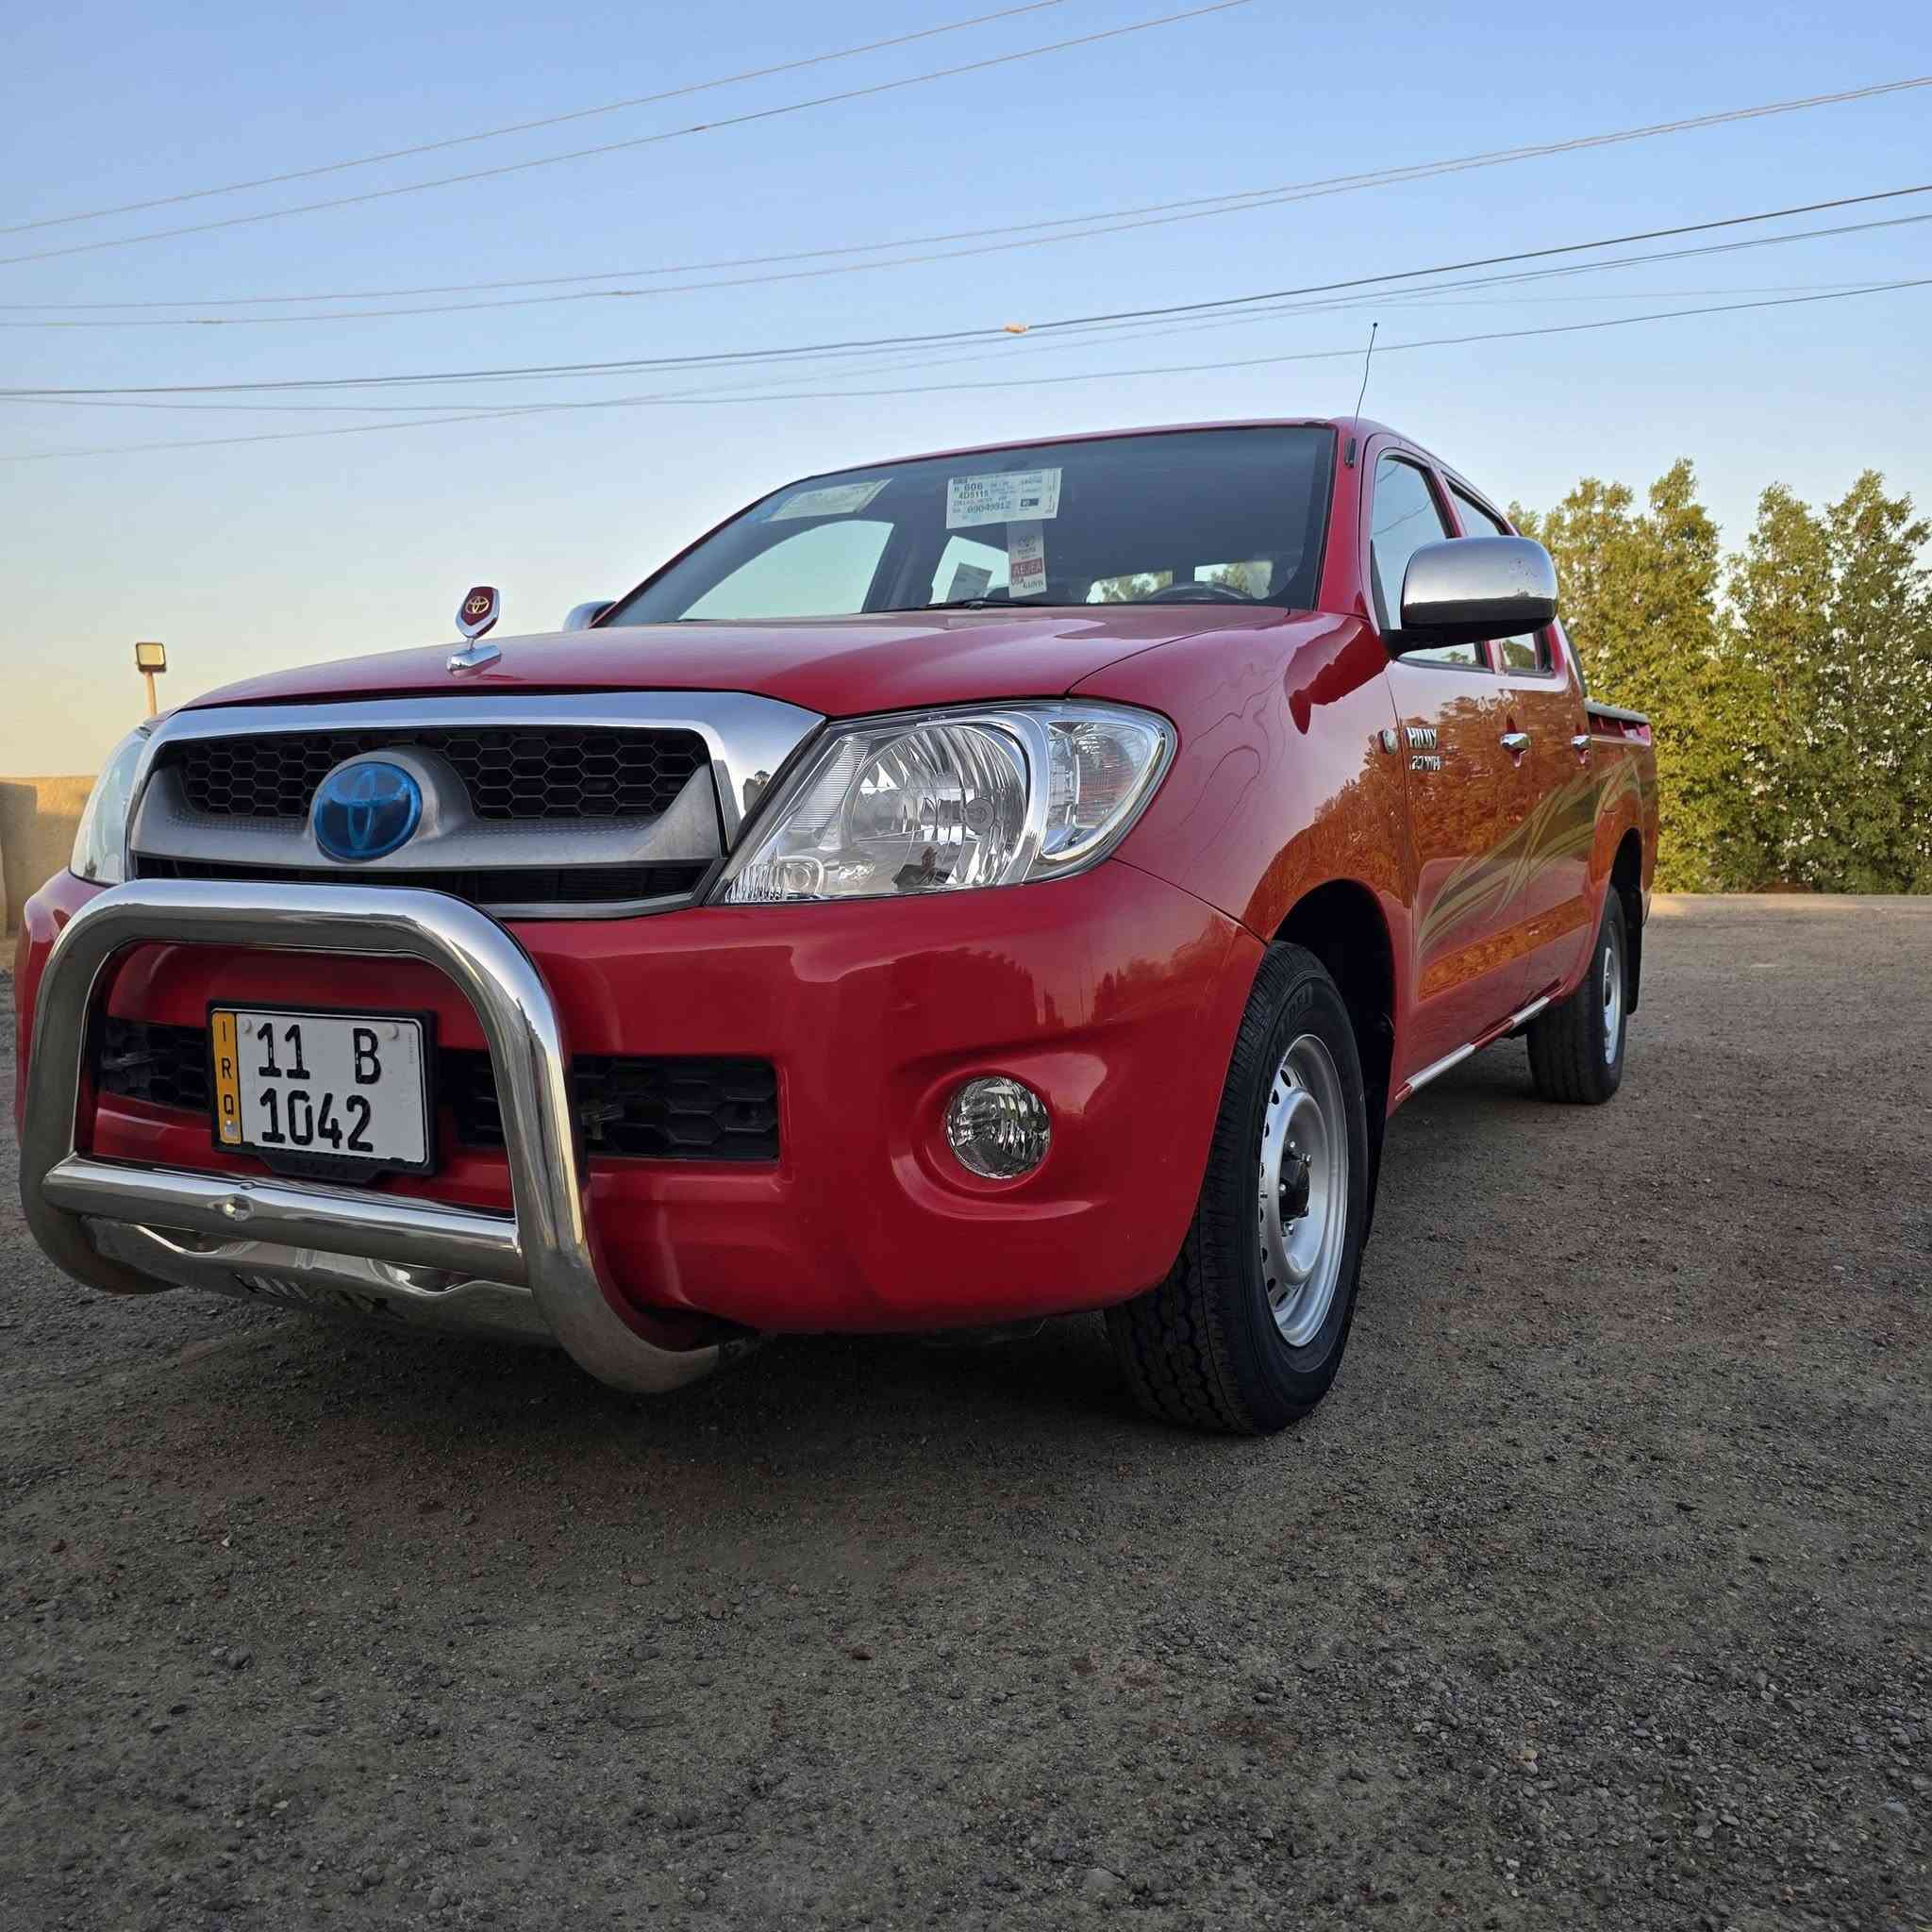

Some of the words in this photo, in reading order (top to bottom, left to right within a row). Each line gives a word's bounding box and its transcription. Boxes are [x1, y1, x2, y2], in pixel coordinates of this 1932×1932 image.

[221, 1020, 235, 1116] IRQ
[257, 1023, 309, 1079] 11
[352, 1027, 382, 1085] B
[259, 1088, 375, 1153] 1042
